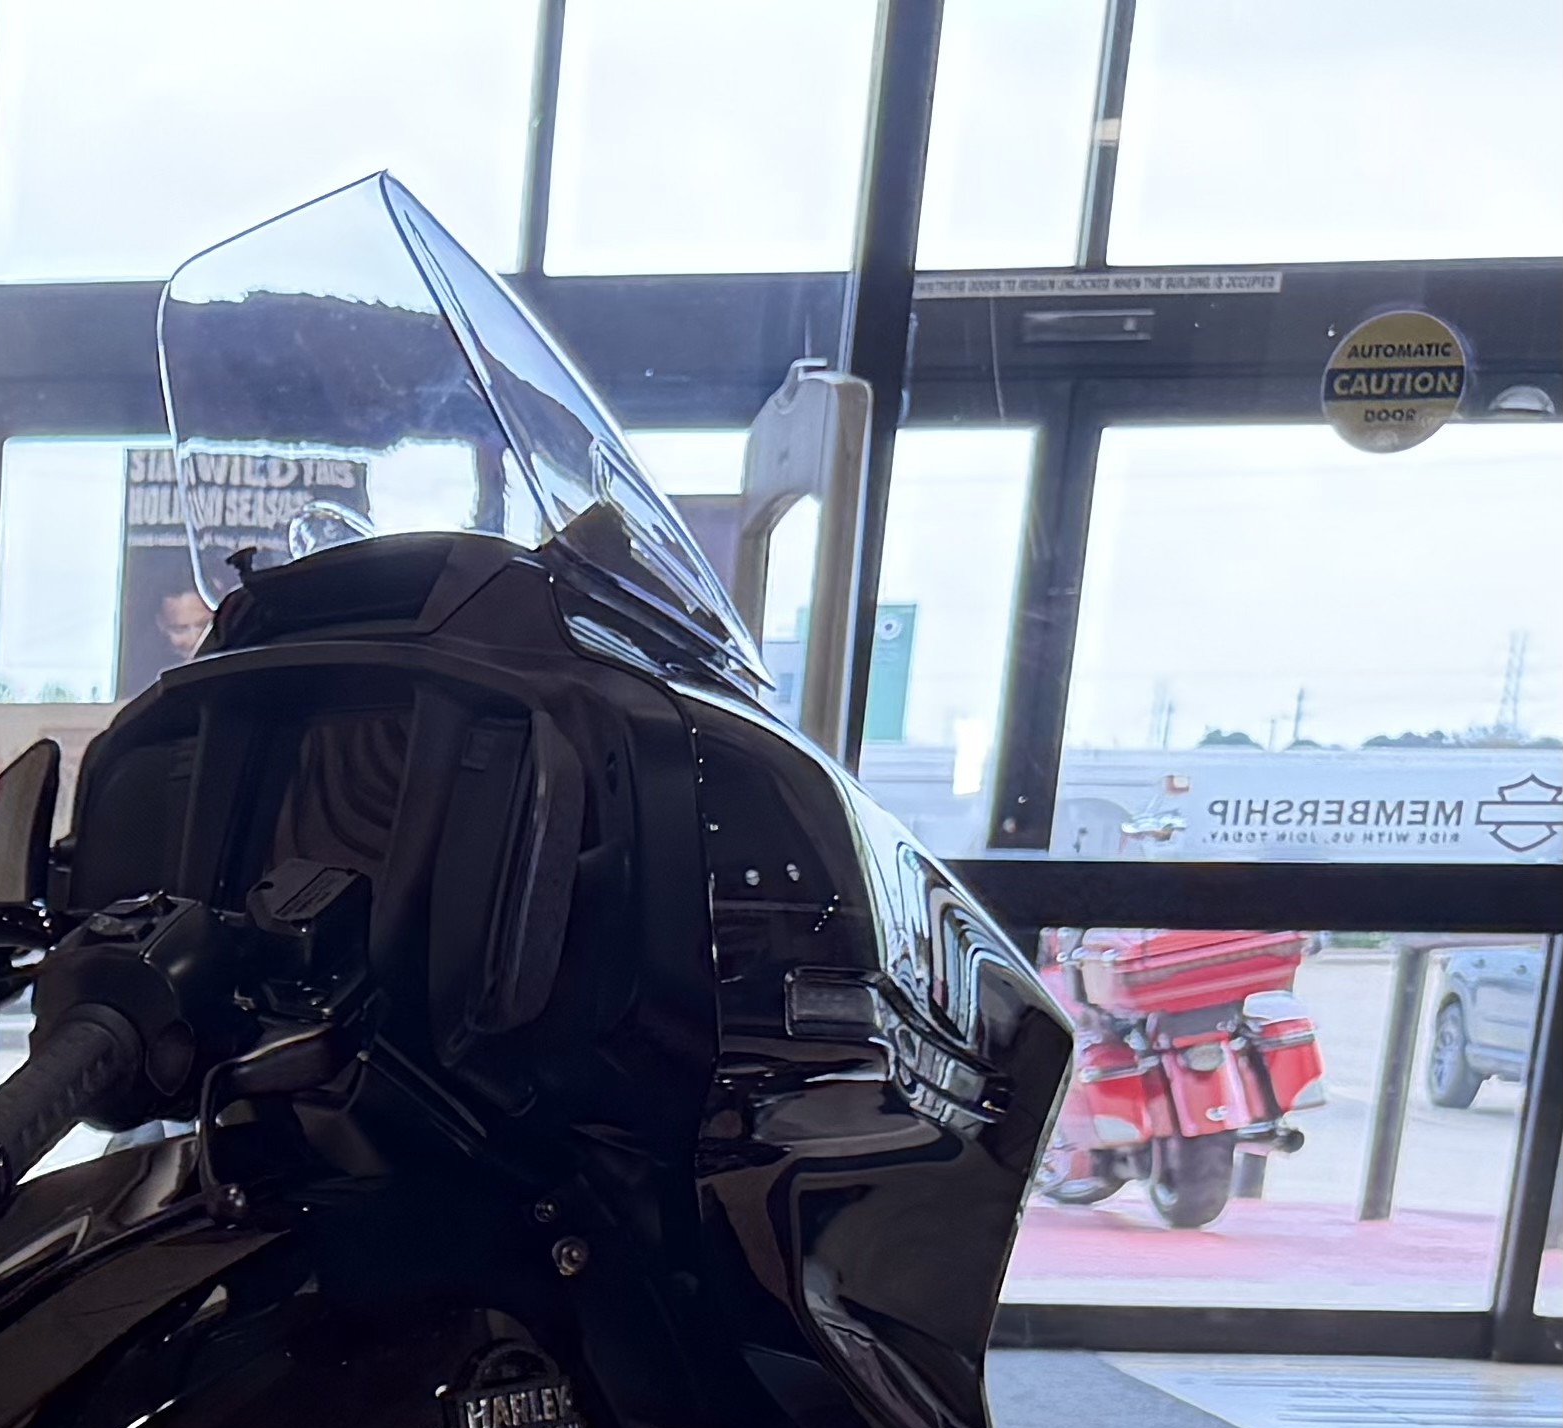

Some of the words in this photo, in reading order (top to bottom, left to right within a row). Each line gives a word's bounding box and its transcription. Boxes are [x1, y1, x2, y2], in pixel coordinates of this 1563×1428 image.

[1347, 342, 1453, 359] AUTOMATIC
[1333, 371, 1458, 396] CAUTION
[1364, 408, 1417, 422] DOOR
[195, 454, 300, 488] WILD
